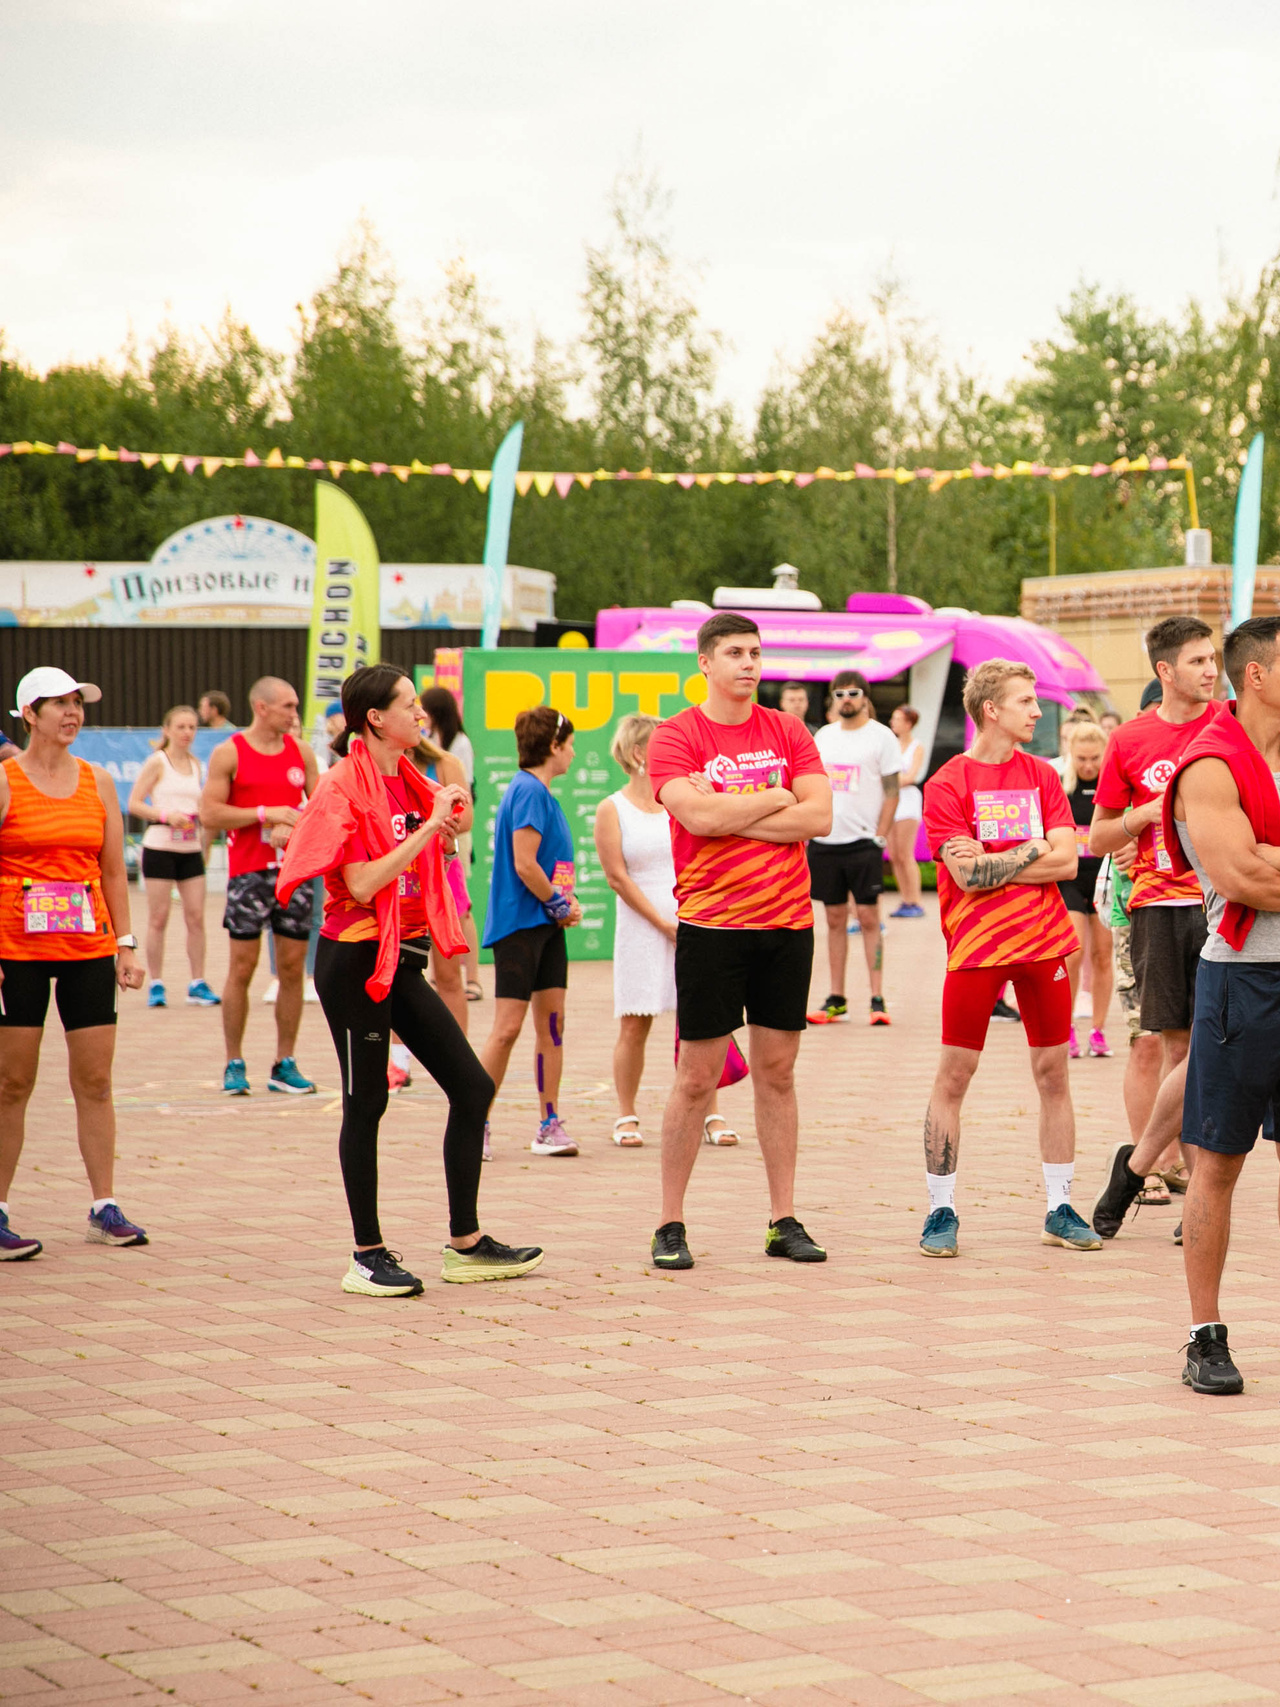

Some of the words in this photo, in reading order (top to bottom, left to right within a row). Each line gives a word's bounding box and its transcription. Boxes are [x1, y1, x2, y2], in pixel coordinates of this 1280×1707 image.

[122, 573, 279, 606] Призовые
[316, 560, 358, 698] МЯСНОЙ
[736, 749, 777, 762] ПИЦЦА
[978, 804, 1020, 820] 250
[27, 897, 69, 912] 183
